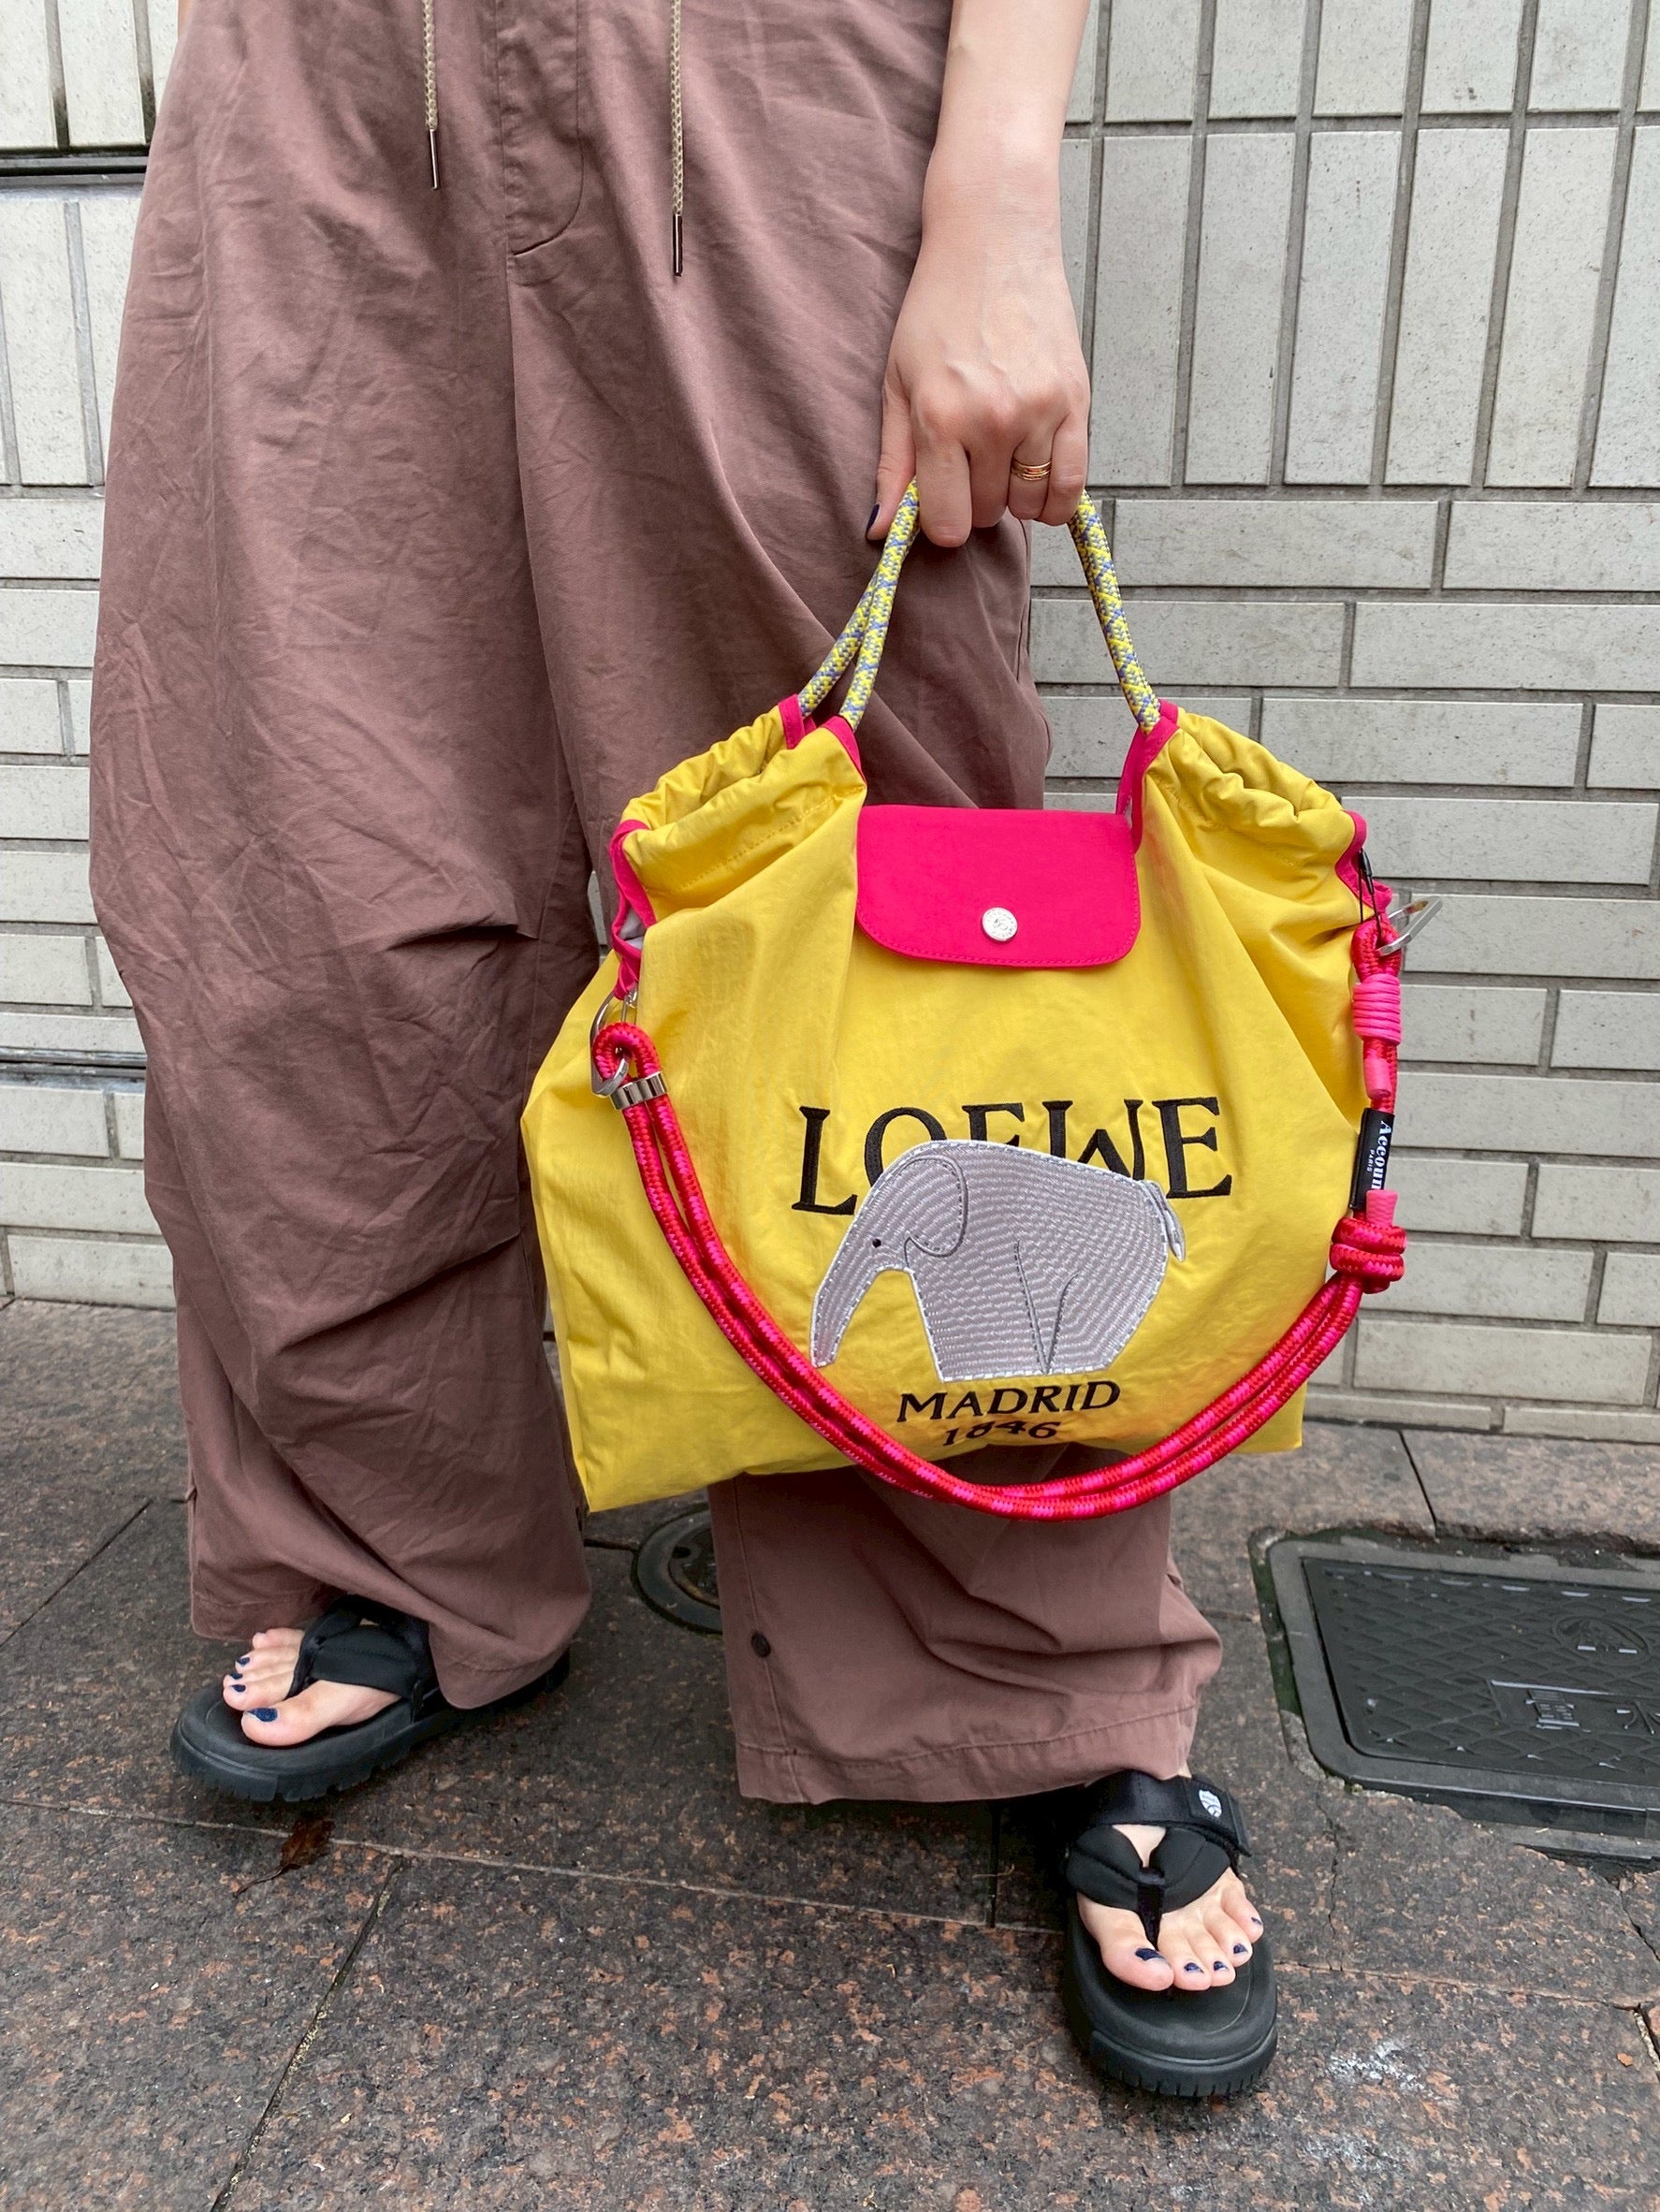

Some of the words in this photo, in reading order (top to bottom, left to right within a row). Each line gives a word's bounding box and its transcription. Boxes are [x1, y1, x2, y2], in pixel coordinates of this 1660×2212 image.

[1366, 1149, 1376, 1172] PARIS
[896, 1380, 1121, 1422] MADRID
[942, 1419, 1062, 1447] 1846
